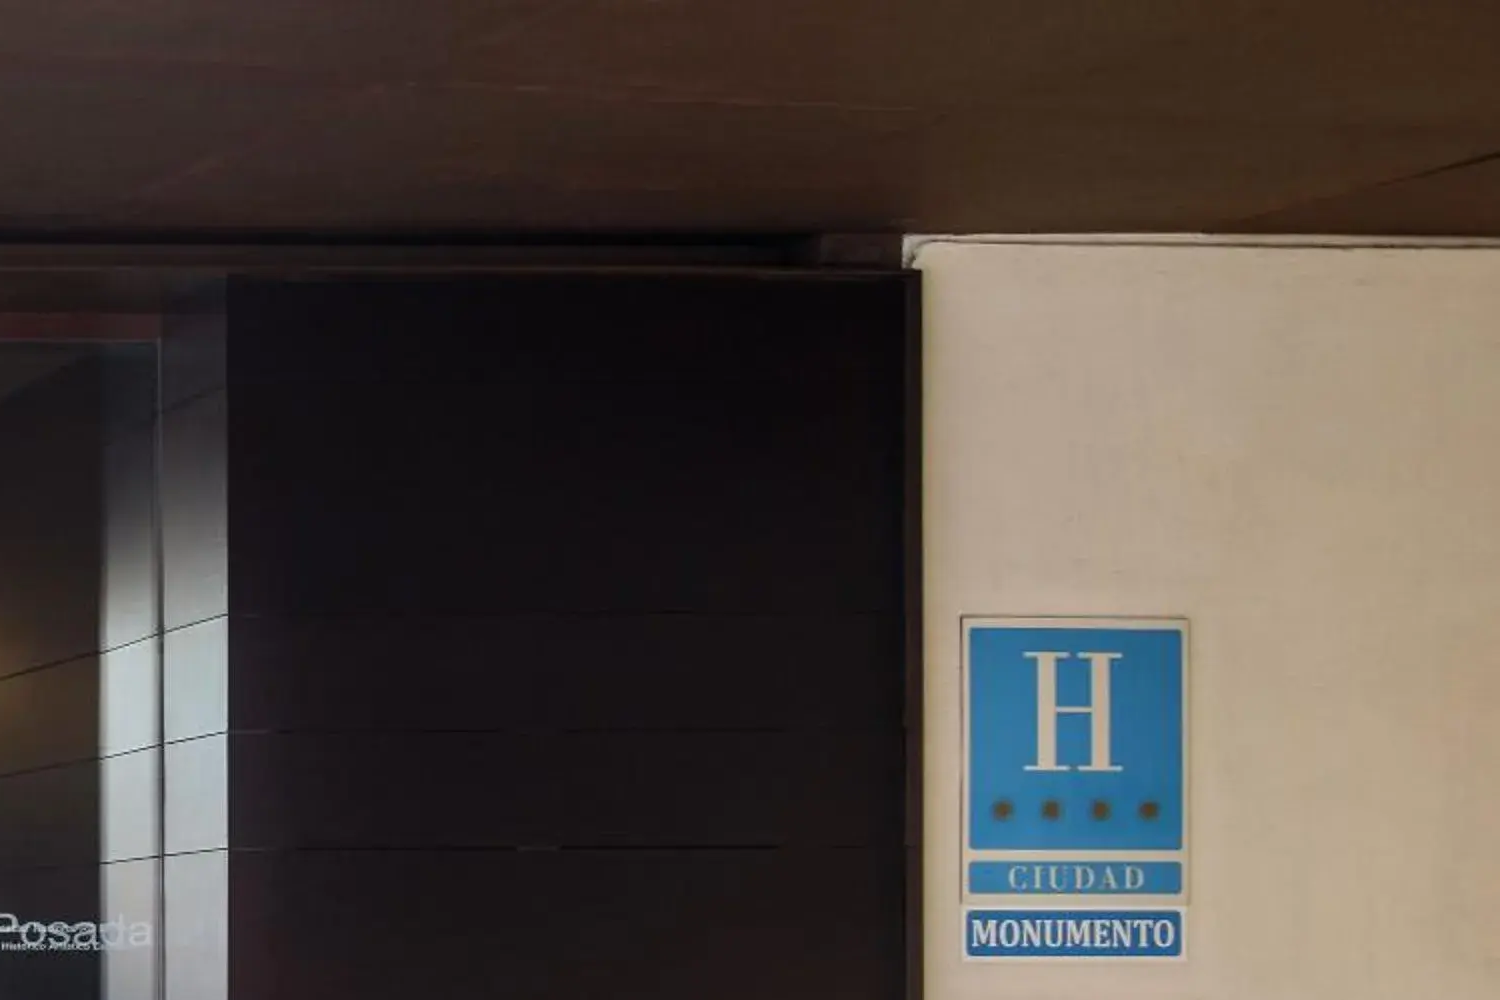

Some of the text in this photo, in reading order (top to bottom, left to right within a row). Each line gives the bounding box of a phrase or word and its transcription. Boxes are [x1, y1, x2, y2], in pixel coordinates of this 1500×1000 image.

[1022, 651, 1123, 772] H
[1008, 865, 1145, 890] CIUDAD
[971, 919, 1175, 948] MONUMENTO
